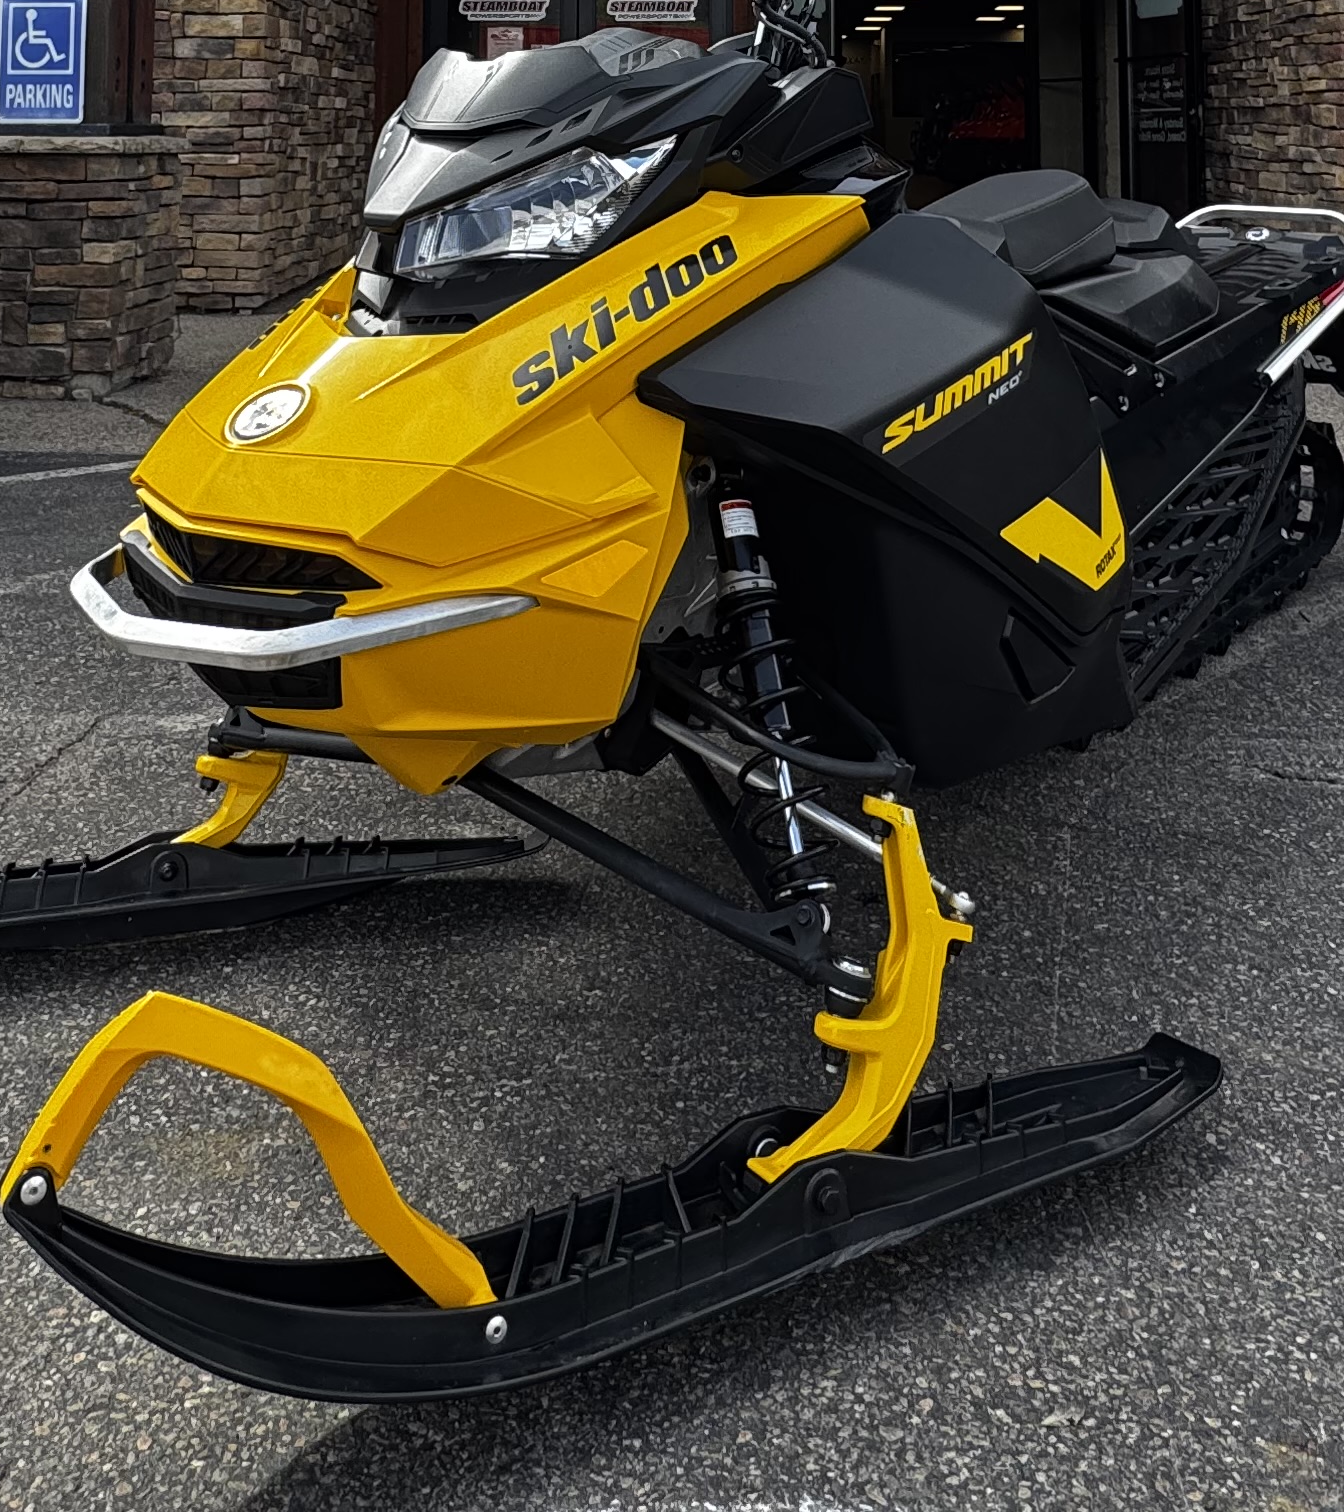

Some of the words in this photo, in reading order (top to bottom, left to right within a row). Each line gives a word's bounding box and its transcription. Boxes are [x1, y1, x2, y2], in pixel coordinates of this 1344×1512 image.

[462, 0, 548, 13] STEAMBOAT
[608, 0, 695, 13] STEAMBOAT
[5, 83, 74, 108] PARKING
[512, 235, 738, 406] ski-doo
[882, 331, 1033, 455] SUMMIT
